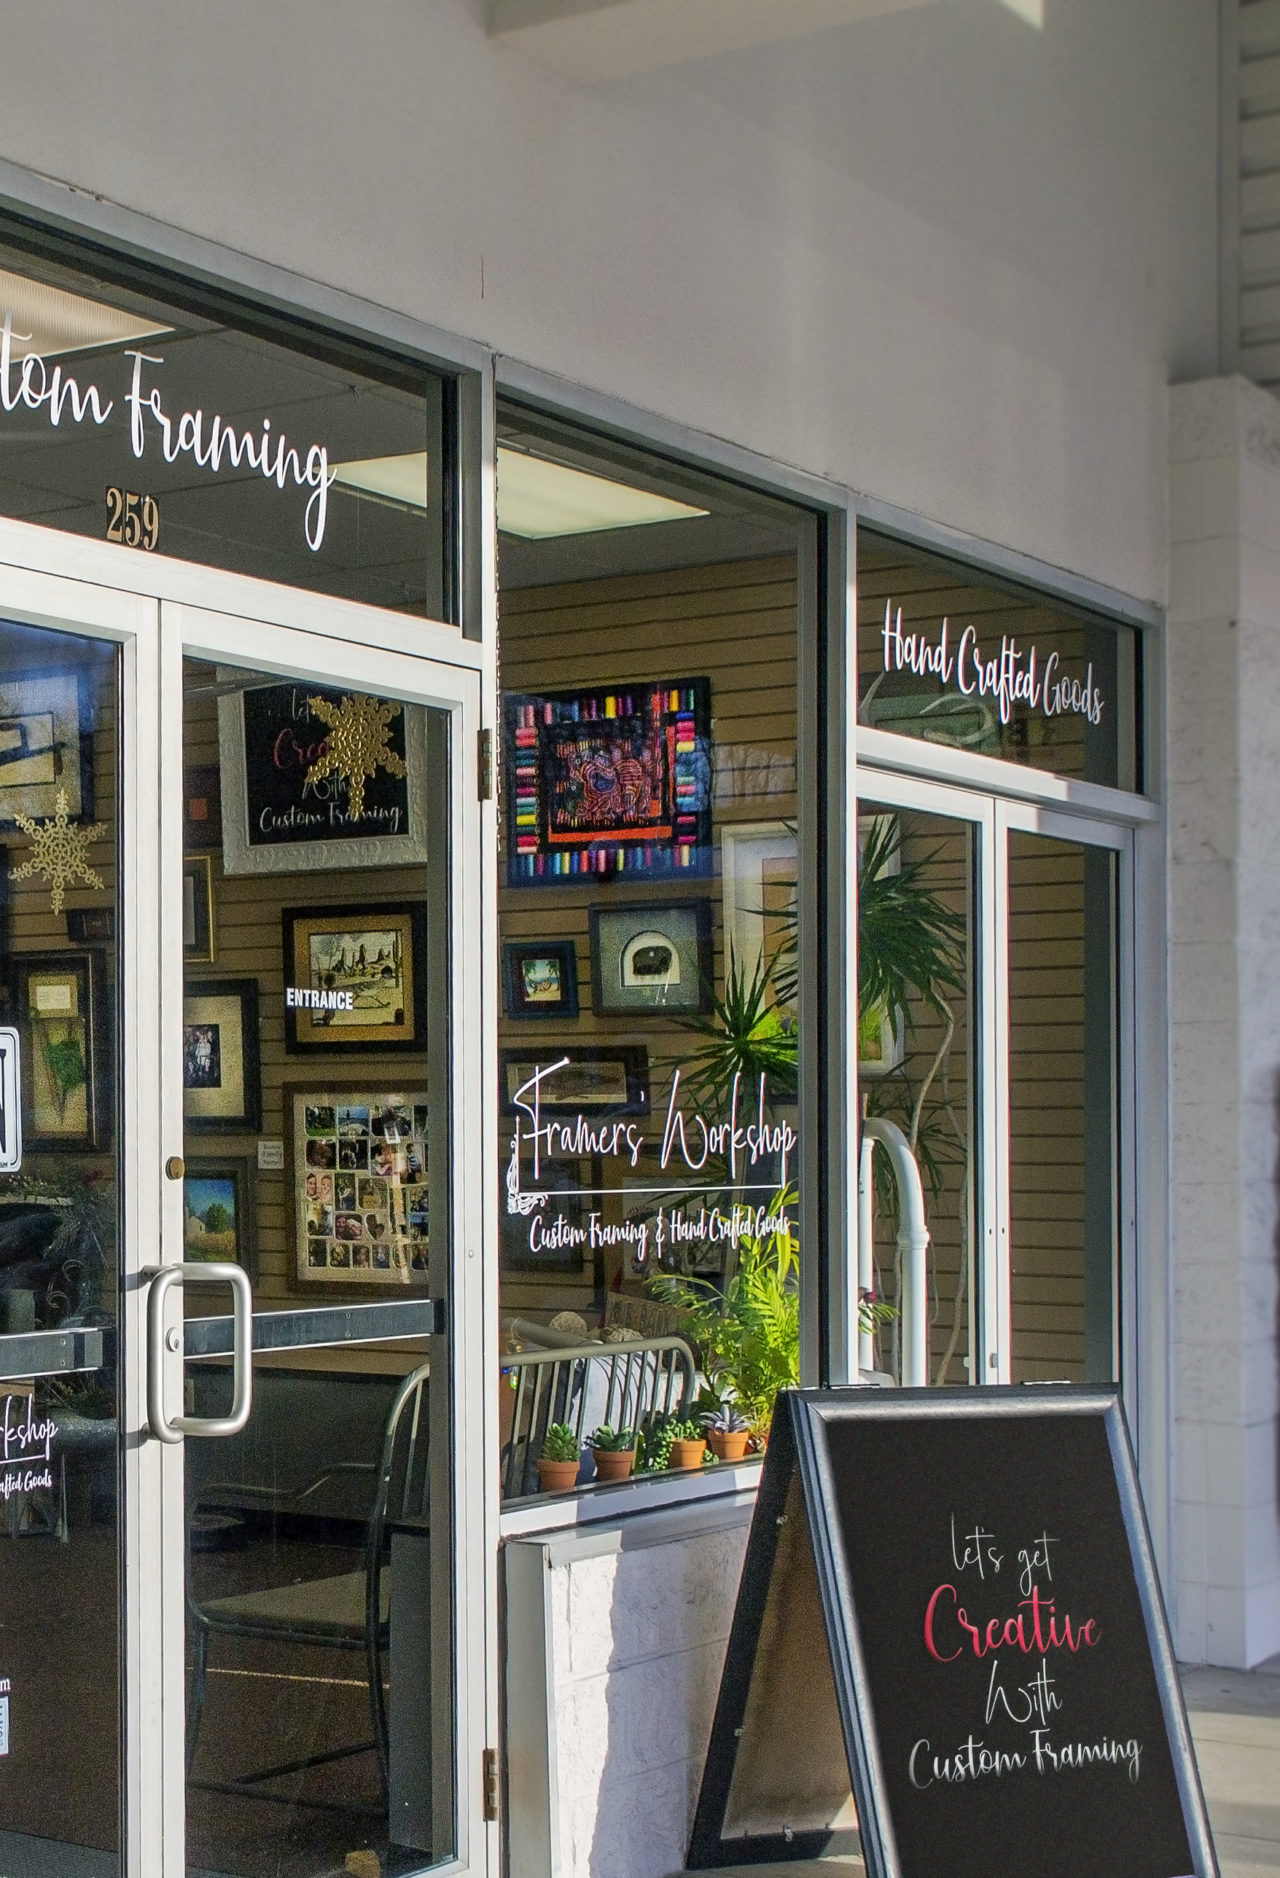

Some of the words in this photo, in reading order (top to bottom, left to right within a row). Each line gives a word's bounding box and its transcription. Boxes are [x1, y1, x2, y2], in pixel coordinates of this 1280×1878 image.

[124, 350, 337, 551] Framing
[106, 486, 160, 552] 259
[881, 599, 953, 683] Hand
[957, 625, 1040, 725] Crafted
[1043, 652, 1104, 725] Goods
[260, 805, 325, 832] Custom
[286, 988, 354, 1010] ENTRANCE
[661, 1070, 797, 1190] Workshop
[530, 1214, 587, 1253] Custom
[588, 1212, 648, 1261] Framing
[656, 1207, 665, 1258] &
[670, 1208, 707, 1244] Hand
[708, 1207, 753, 1250] Crafted
[754, 1205, 791, 1239] Goods
[24, 1468, 53, 1491] Goods
[1017, 1530, 1062, 1597] get
[924, 1584, 1103, 1662] Creative
[985, 1658, 1063, 1726] With
[908, 1734, 1027, 1790] Custom
[1029, 1728, 1143, 1784] Framing
